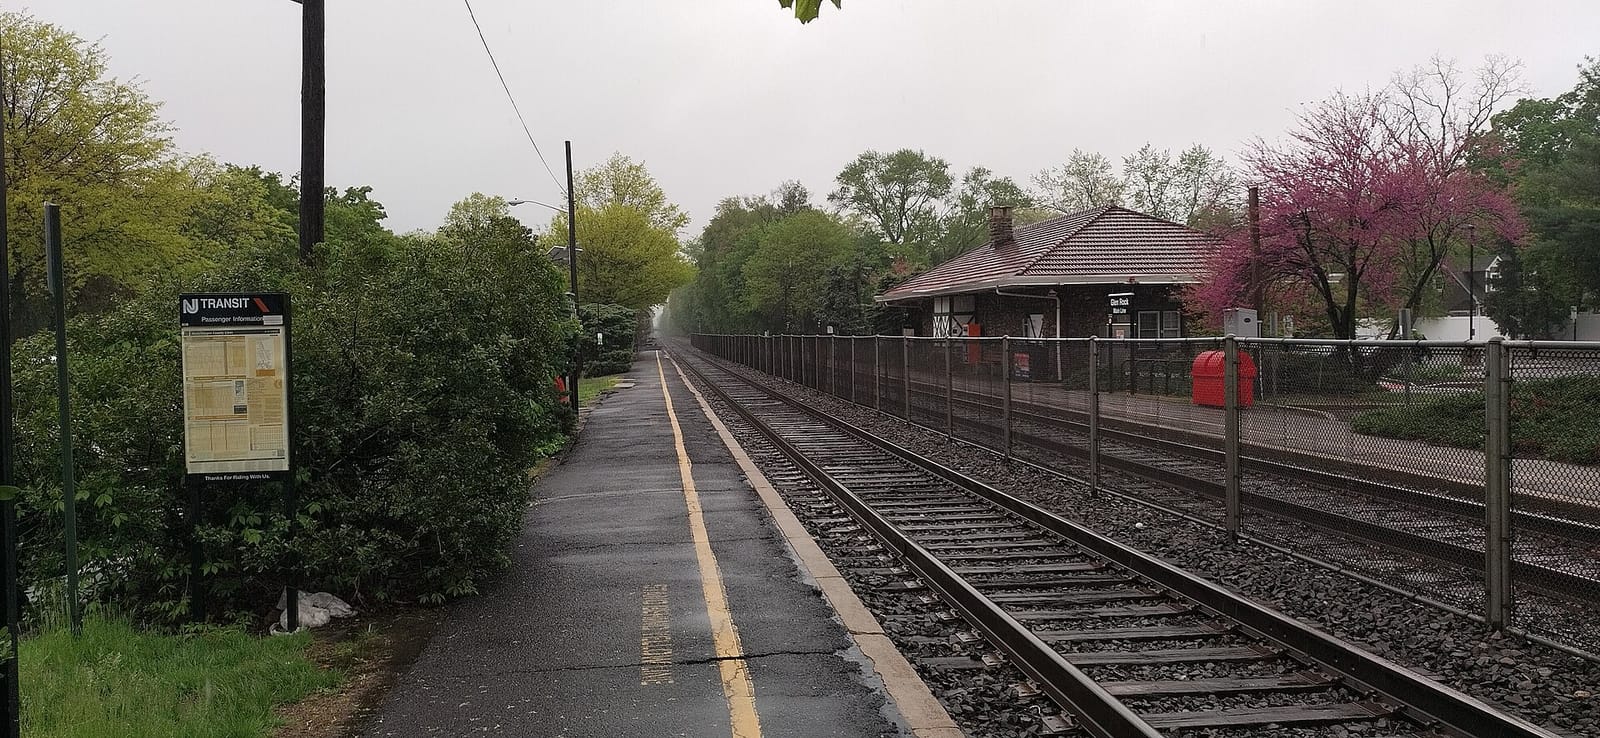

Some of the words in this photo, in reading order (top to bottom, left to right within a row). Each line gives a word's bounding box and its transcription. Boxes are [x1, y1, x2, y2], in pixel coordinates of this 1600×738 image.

[182, 298, 199, 314] NJ
[200, 297, 250, 309] TRANSIT
[201, 316, 232, 324] Passenger
